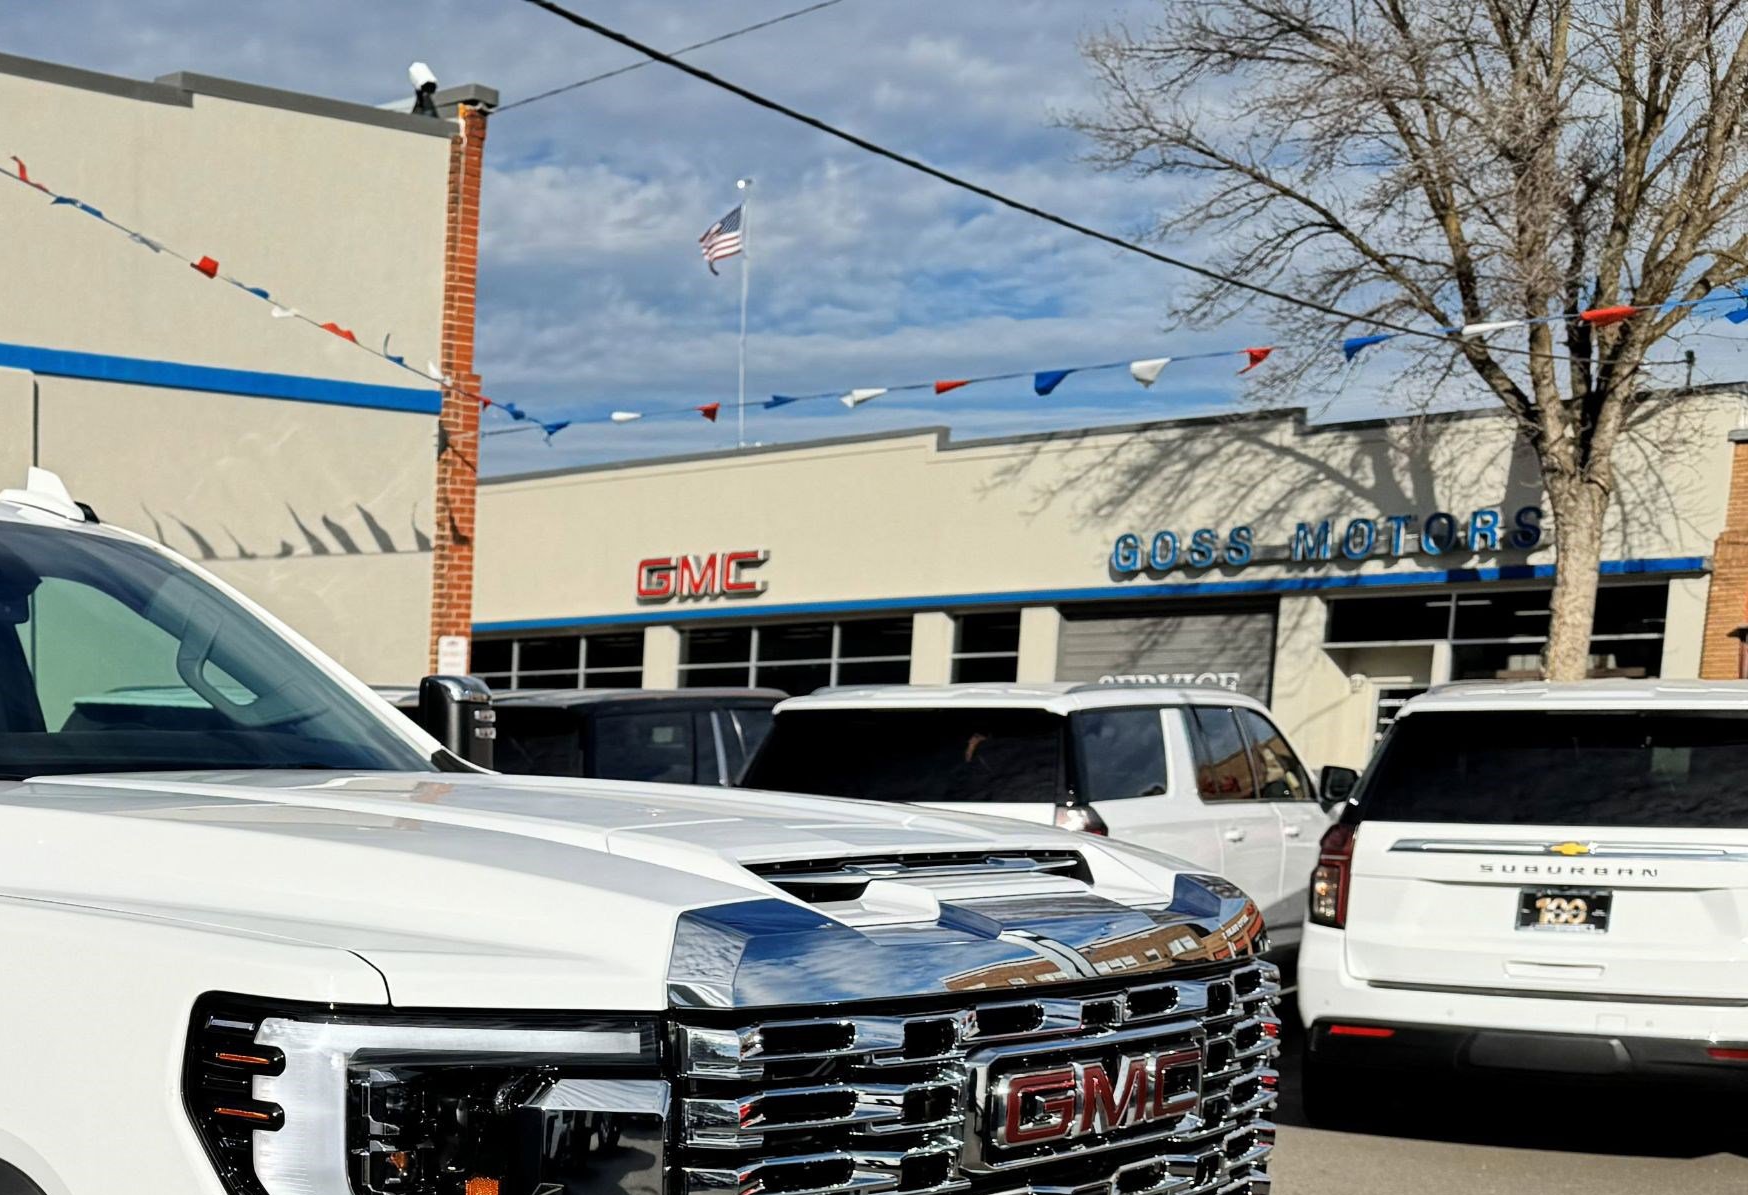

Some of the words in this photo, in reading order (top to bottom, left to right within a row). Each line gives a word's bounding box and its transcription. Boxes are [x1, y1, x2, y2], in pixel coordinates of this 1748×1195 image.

[1114, 526, 1253, 572] GOSS
[1291, 506, 1544, 562] MOTORS
[637, 549, 766, 599] GMC
[1479, 864, 1659, 878] SUBURBAN
[1004, 1049, 1202, 1146] GMC
